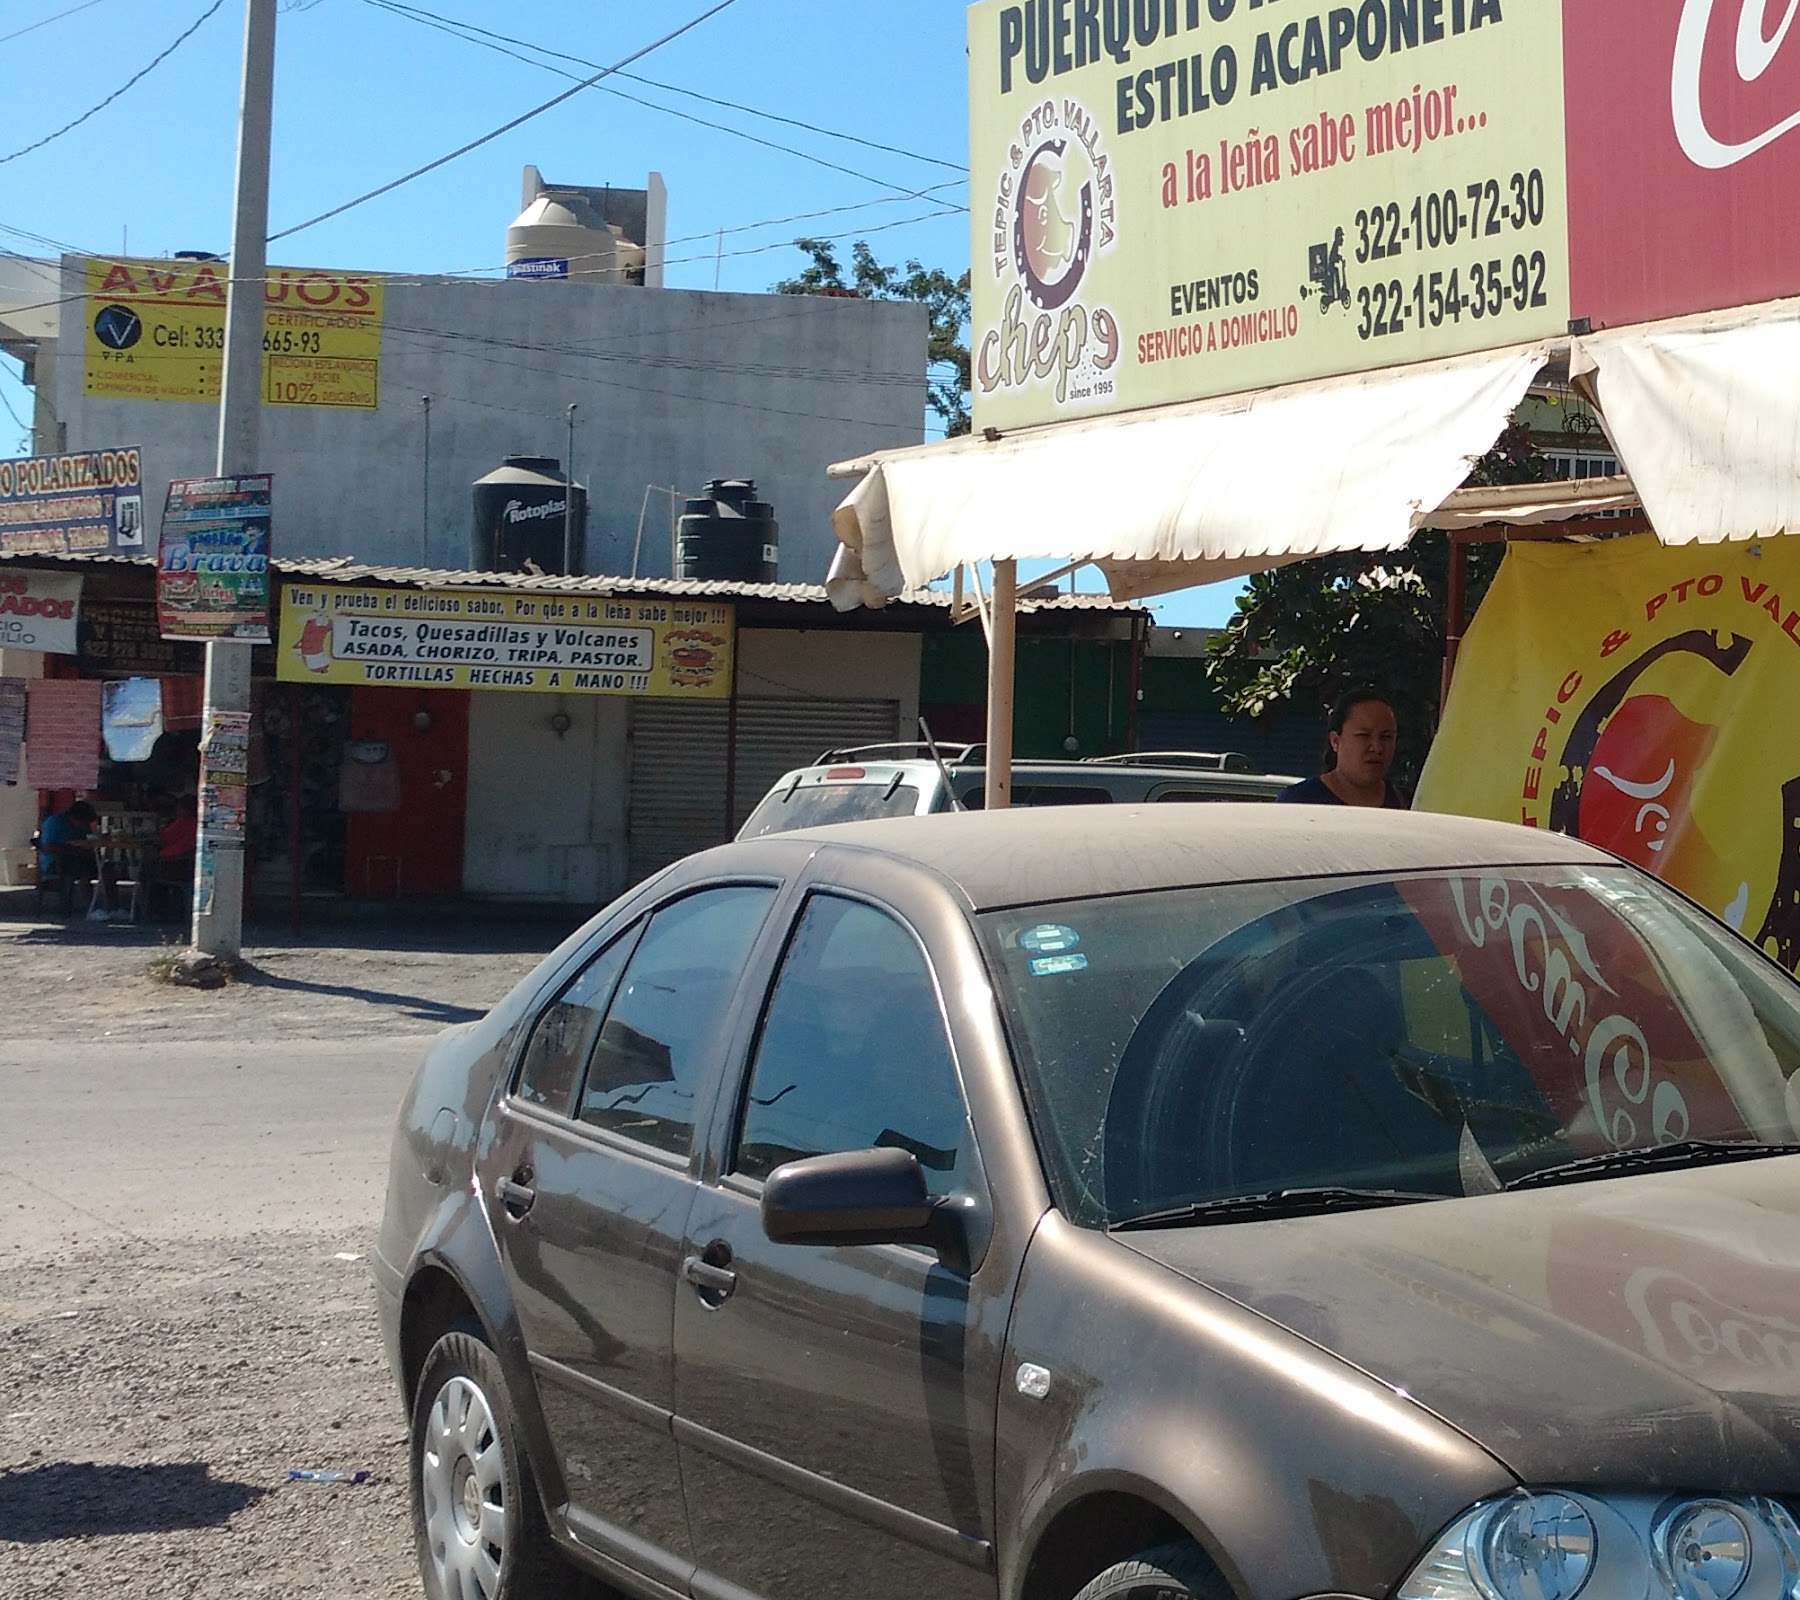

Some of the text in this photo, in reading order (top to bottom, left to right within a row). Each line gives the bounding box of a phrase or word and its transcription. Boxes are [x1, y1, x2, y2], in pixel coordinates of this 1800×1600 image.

[1116, 44, 1237, 136] ESTILO
[1161, 84, 1488, 209] a la leña sabe mejor...
[994, 99, 1115, 278] TEPIC & PTO. VALLARTA
[1354, 168, 1545, 264] 322-100-72-30
[101, 264, 370, 308] AVAUOS
[1170, 269, 1259, 317] EVENTOS
[1356, 250, 1547, 340] 322-154-35-92
[153, 324, 189, 348] Cel:
[1136, 304, 1298, 365] SERVICIO A DOMICILIO
[274, 381, 318, 402] 10%
[1070, 380, 1114, 400] since 1995
[15, 450, 140, 496] POLARIZADOS
[509, 500, 567, 524] Rotoplas
[161, 543, 267, 574] Brava
[291, 588, 314, 606] Ven
[320, 594, 328, 609] y
[334, 592, 378, 610] prueba
[385, 594, 397, 609] el
[404, 594, 460, 612] delicioso
[467, 598, 505, 616] sabor,
[516, 599, 536, 616] Por
[572, 604, 579, 618] a
[586, 603, 598, 618] la
[605, 603, 631, 619] leña
[638, 605, 667, 622] sabe
[673, 607, 707, 626] mejor
[342, 642, 643, 667] ASADA, CHORIZO, TRIPA, PASTOR.
[350, 620, 640, 649] Tacos, Quesadillas y Volcanes
[365, 664, 455, 682] TORTILLAS
[469, 668, 535, 685] HECHAS
[549, 672, 560, 686] A
[575, 673, 624, 689] MANO
[1522, 670, 1583, 828] TEPIC
[1600, 629, 1632, 658] &
[1645, 574, 1724, 621] PTO
